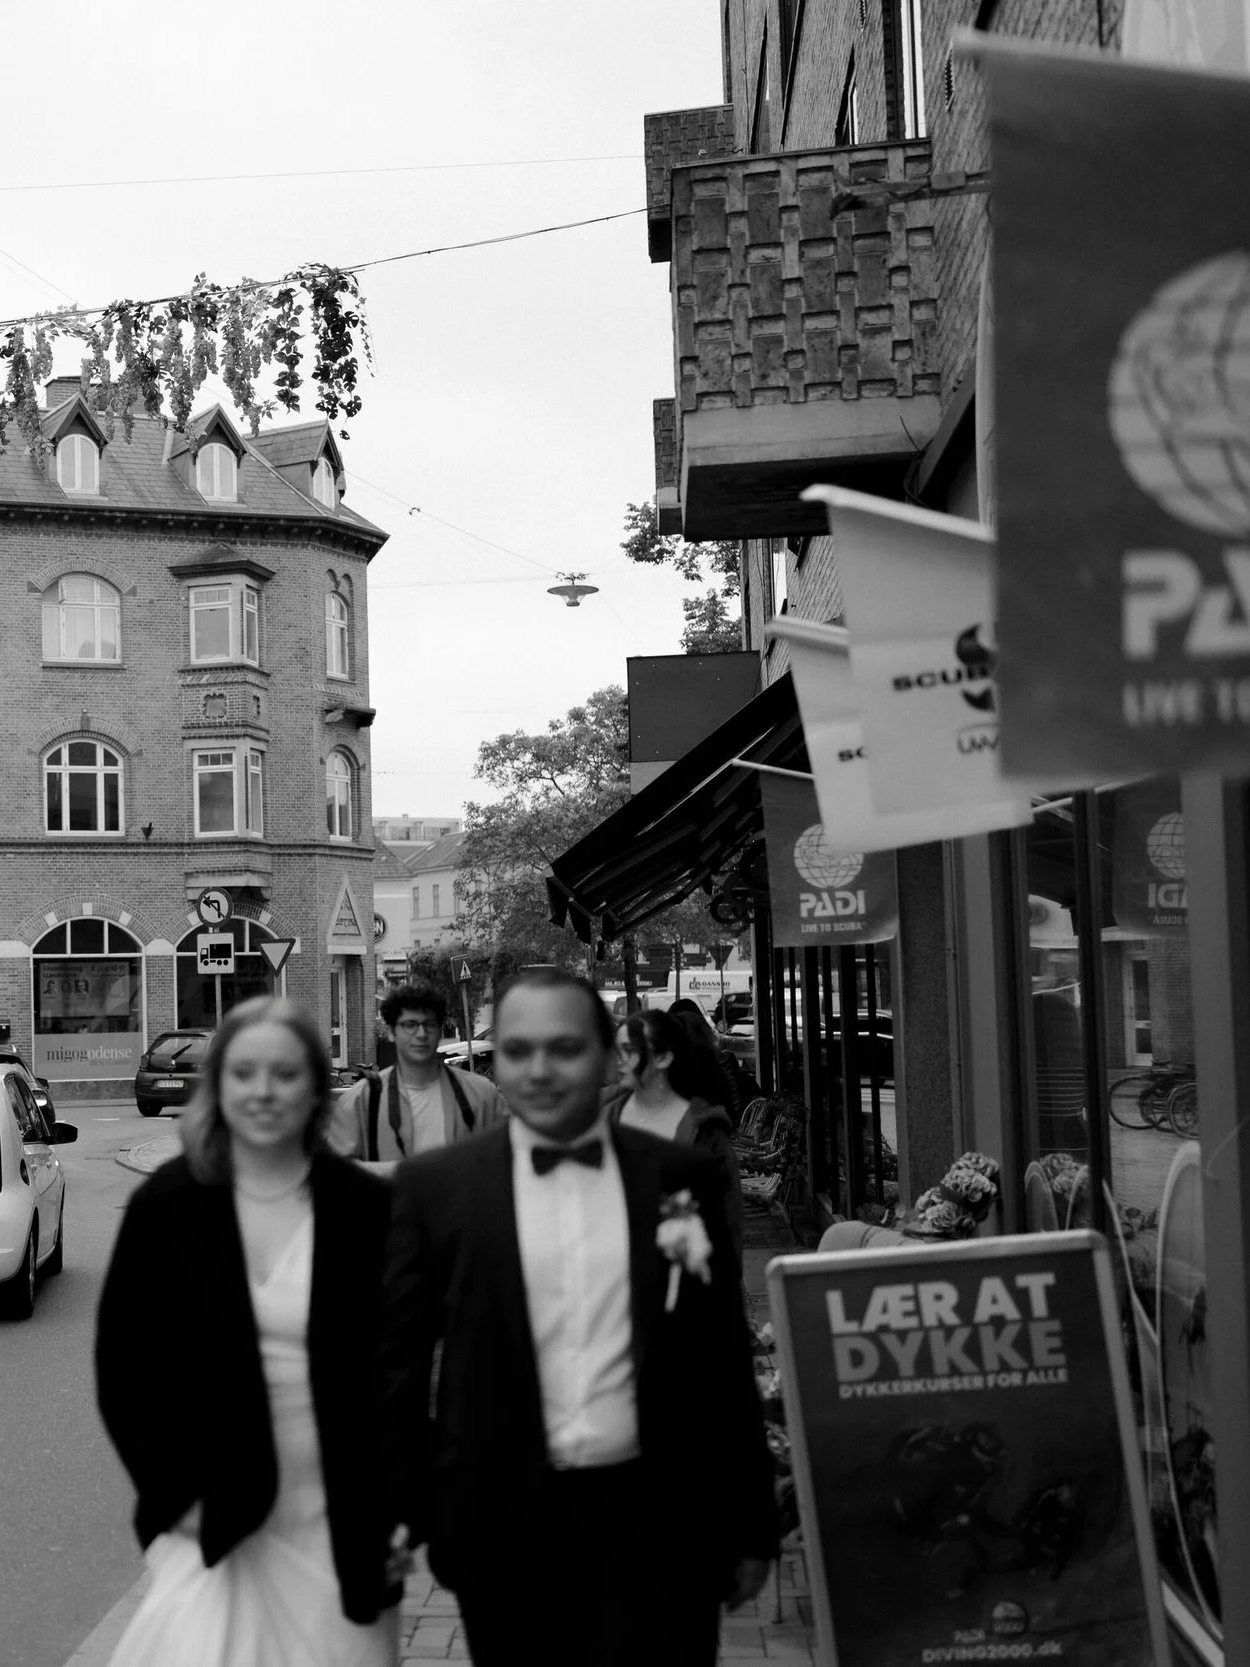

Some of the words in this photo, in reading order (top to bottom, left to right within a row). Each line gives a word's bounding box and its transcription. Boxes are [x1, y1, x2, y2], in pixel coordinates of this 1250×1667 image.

[799, 889, 866, 918] PADI
[801, 924, 818, 933] LIVE
[820, 923, 832, 932] TO
[833, 921, 862, 932] SCUBA
[46, 1045, 132, 1062] migogodense
[826, 1282, 962, 1336] LÆR
[973, 1272, 1057, 1325] AT
[833, 1319, 1067, 1384] DYKKE
[838, 1377, 985, 1400] DYKKERKURSER
[986, 1373, 1024, 1390] FOR
[1025, 1367, 1069, 1386] ALLE
